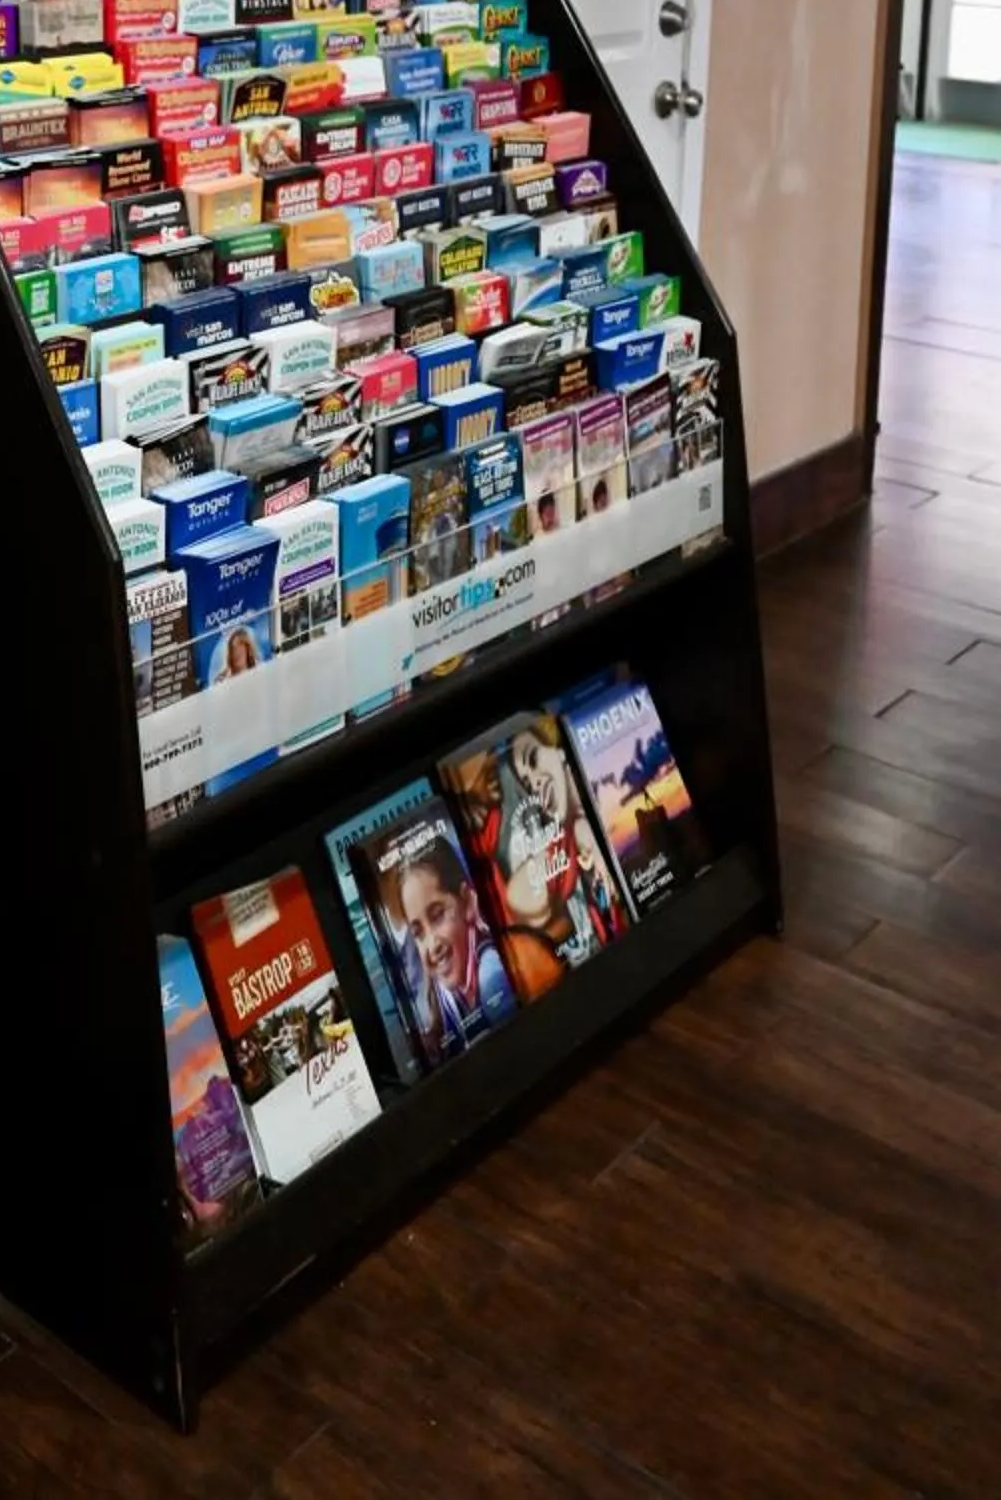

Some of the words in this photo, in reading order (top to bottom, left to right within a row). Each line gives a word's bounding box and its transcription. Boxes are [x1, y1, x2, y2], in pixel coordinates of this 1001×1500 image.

[250, 84, 270, 100] SAN
[2, 118, 67, 140] BRAUNTEX
[271, 309, 305, 326] marcos
[279, 302, 296, 314] san
[196, 330, 233, 346] marcos
[205, 321, 223, 334] san
[126, 403, 161, 422] COUPON
[187, 491, 234, 519] Tanger
[188, 510, 230, 531] OUTLETS
[217, 551, 264, 580] Tanger
[576, 689, 649, 749] PHOENIX
[231, 948, 294, 1021] BASTROP
[305, 1034, 351, 1095] Texas
